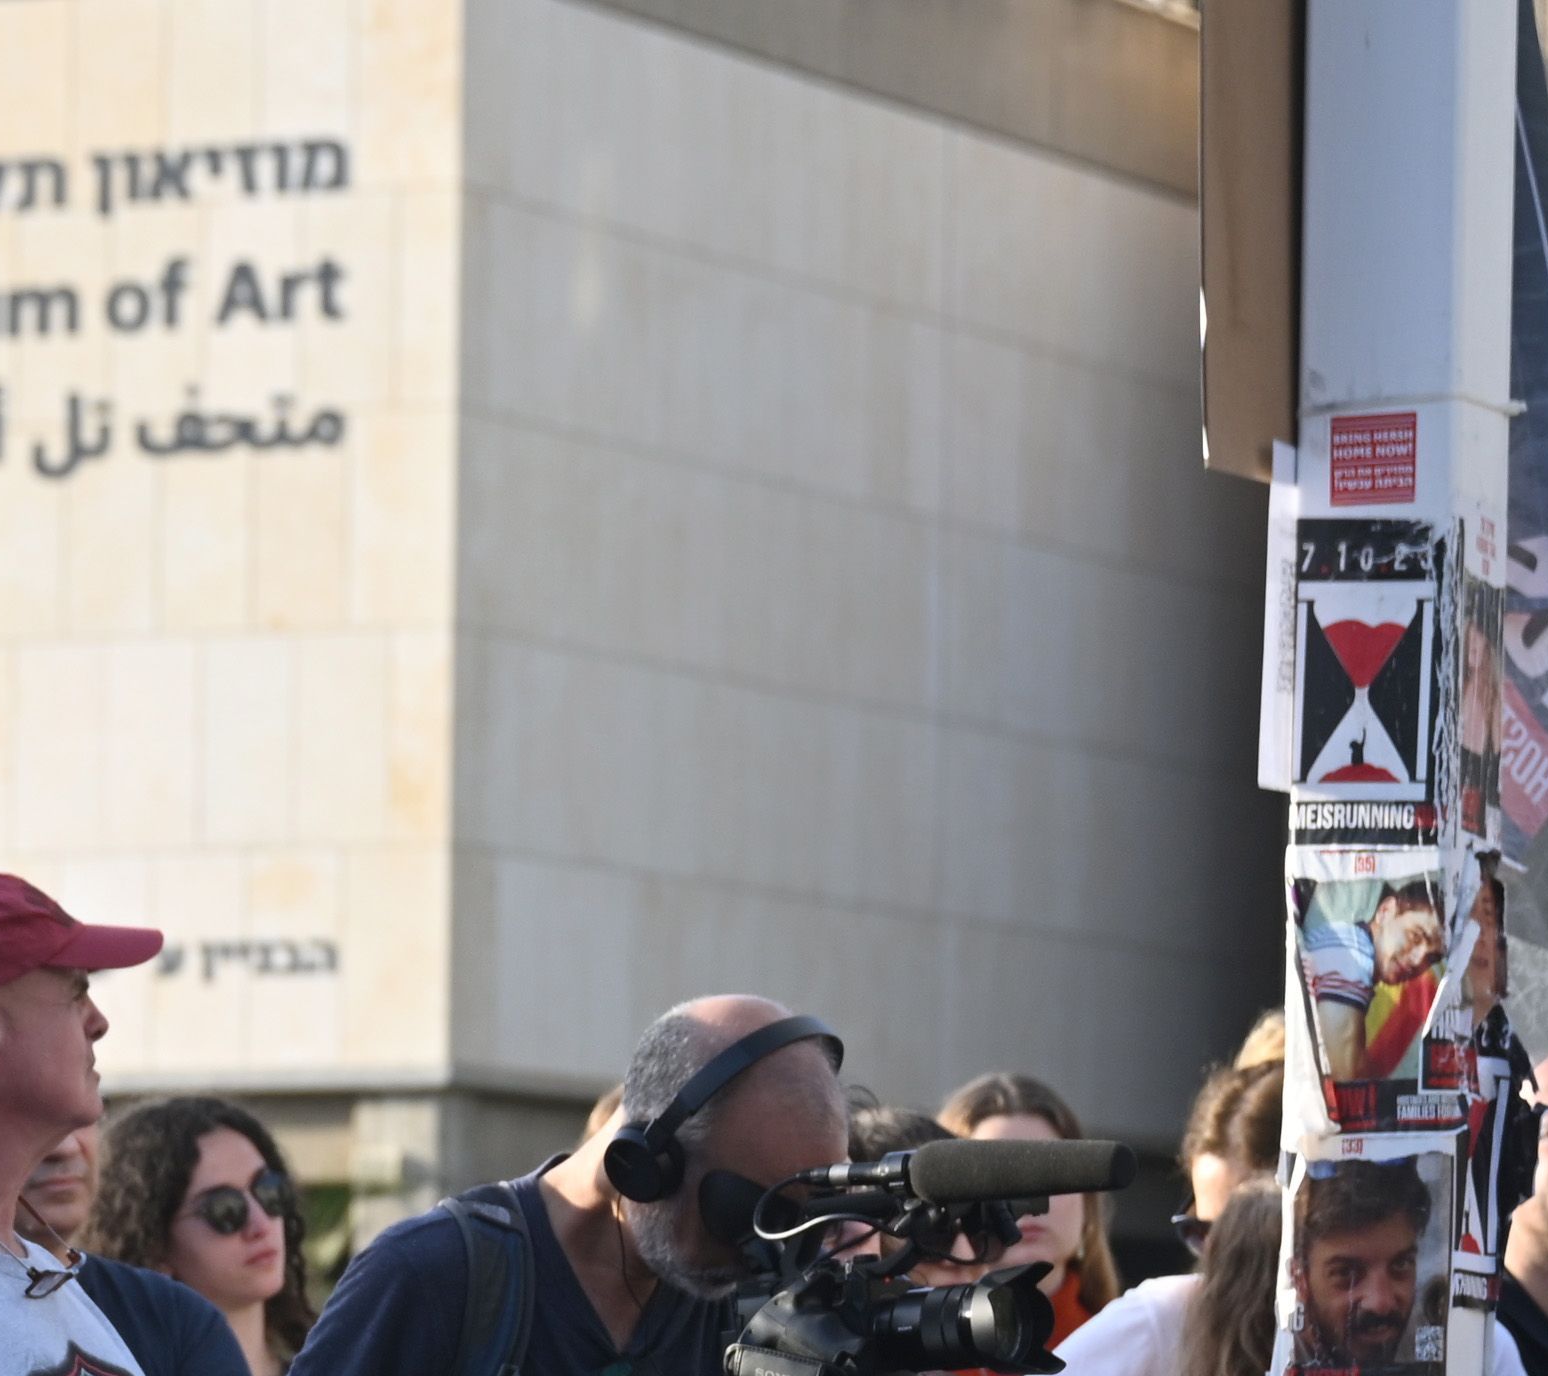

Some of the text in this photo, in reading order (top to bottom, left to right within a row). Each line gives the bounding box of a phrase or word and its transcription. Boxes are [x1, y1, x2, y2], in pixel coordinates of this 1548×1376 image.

[94, 135, 351, 217] מוזיאון
[104, 257, 189, 333] of
[215, 256, 347, 327] Art
[31, 384, 112, 478] تل
[134, 380, 347, 458] متحف
[1334, 445, 1372, 460] HOME
